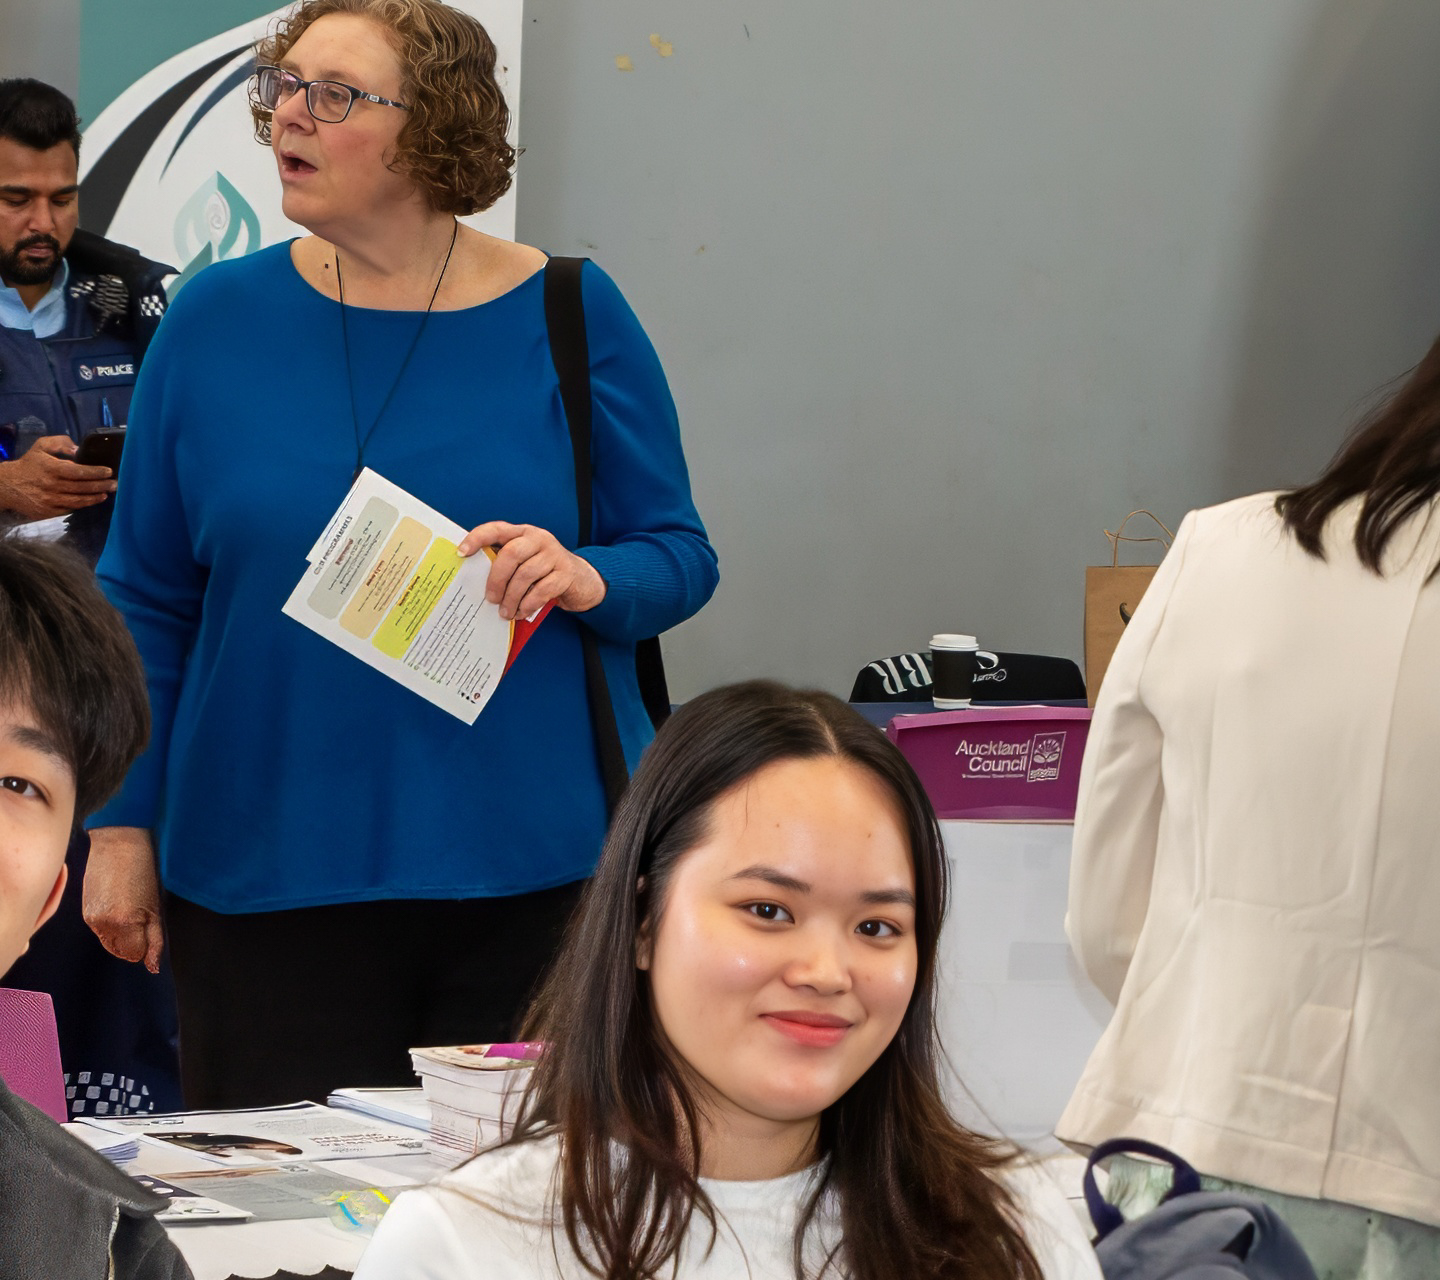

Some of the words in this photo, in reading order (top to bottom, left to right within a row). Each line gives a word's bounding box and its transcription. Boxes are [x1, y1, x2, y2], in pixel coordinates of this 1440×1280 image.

[97, 363, 134, 377] POLICE
[955, 739, 1032, 756] Auckland
[969, 756, 1027, 772] Council
